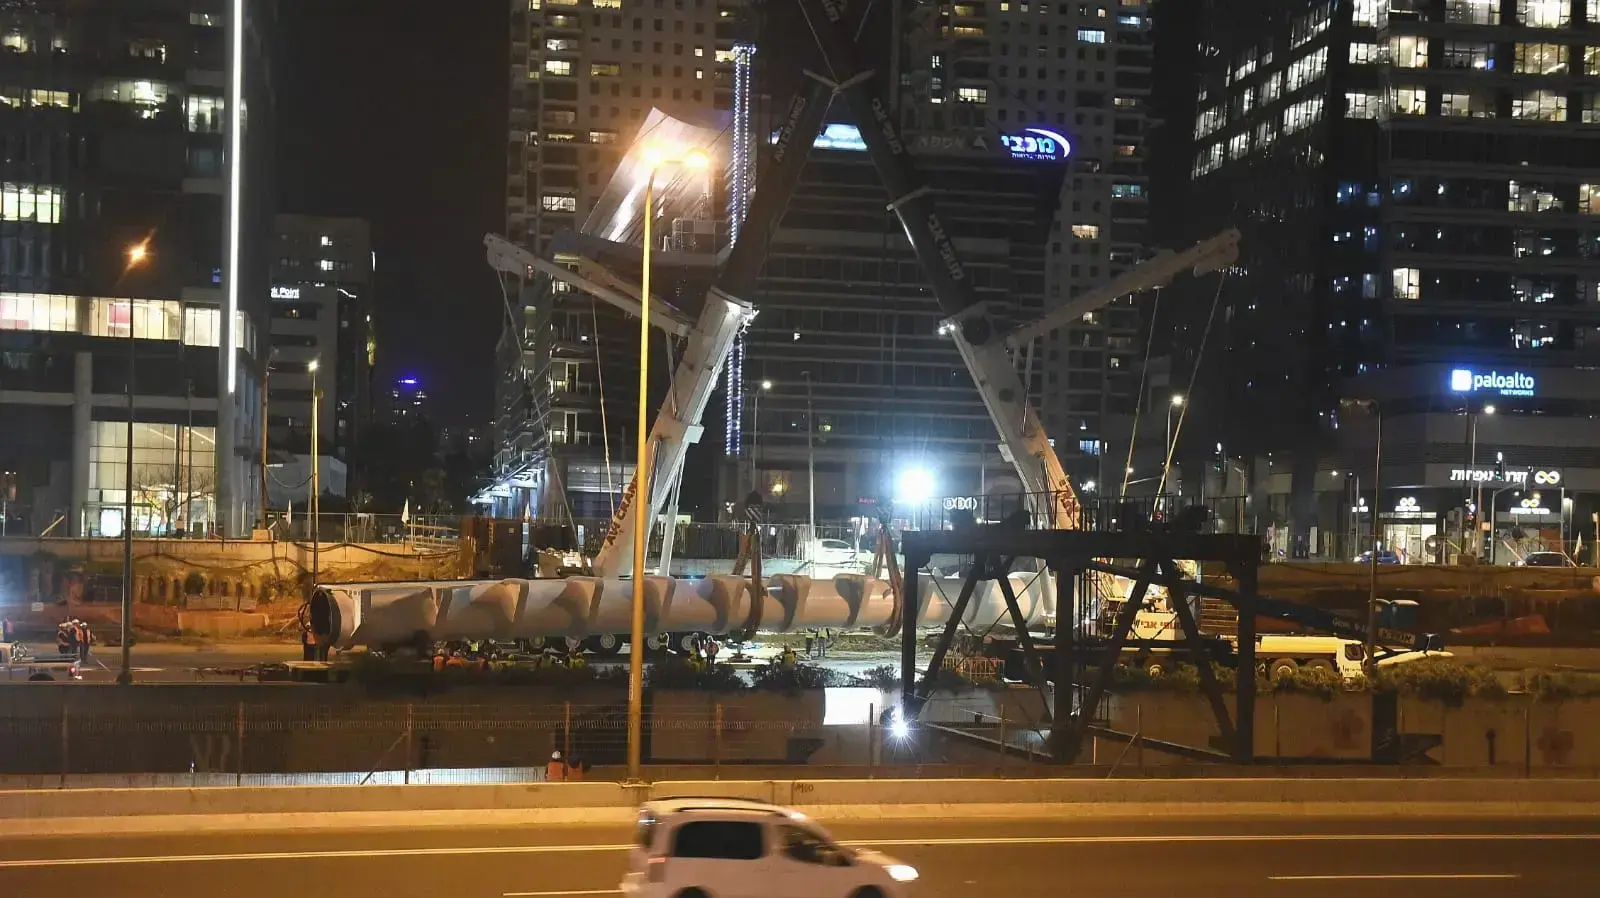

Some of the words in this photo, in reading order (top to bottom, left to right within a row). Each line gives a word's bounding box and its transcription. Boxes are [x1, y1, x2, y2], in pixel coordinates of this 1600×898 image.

[1001, 135, 1056, 154] מכבי
[1474, 370, 1534, 391] paloalto
[616, 465, 638, 521] CRAN
